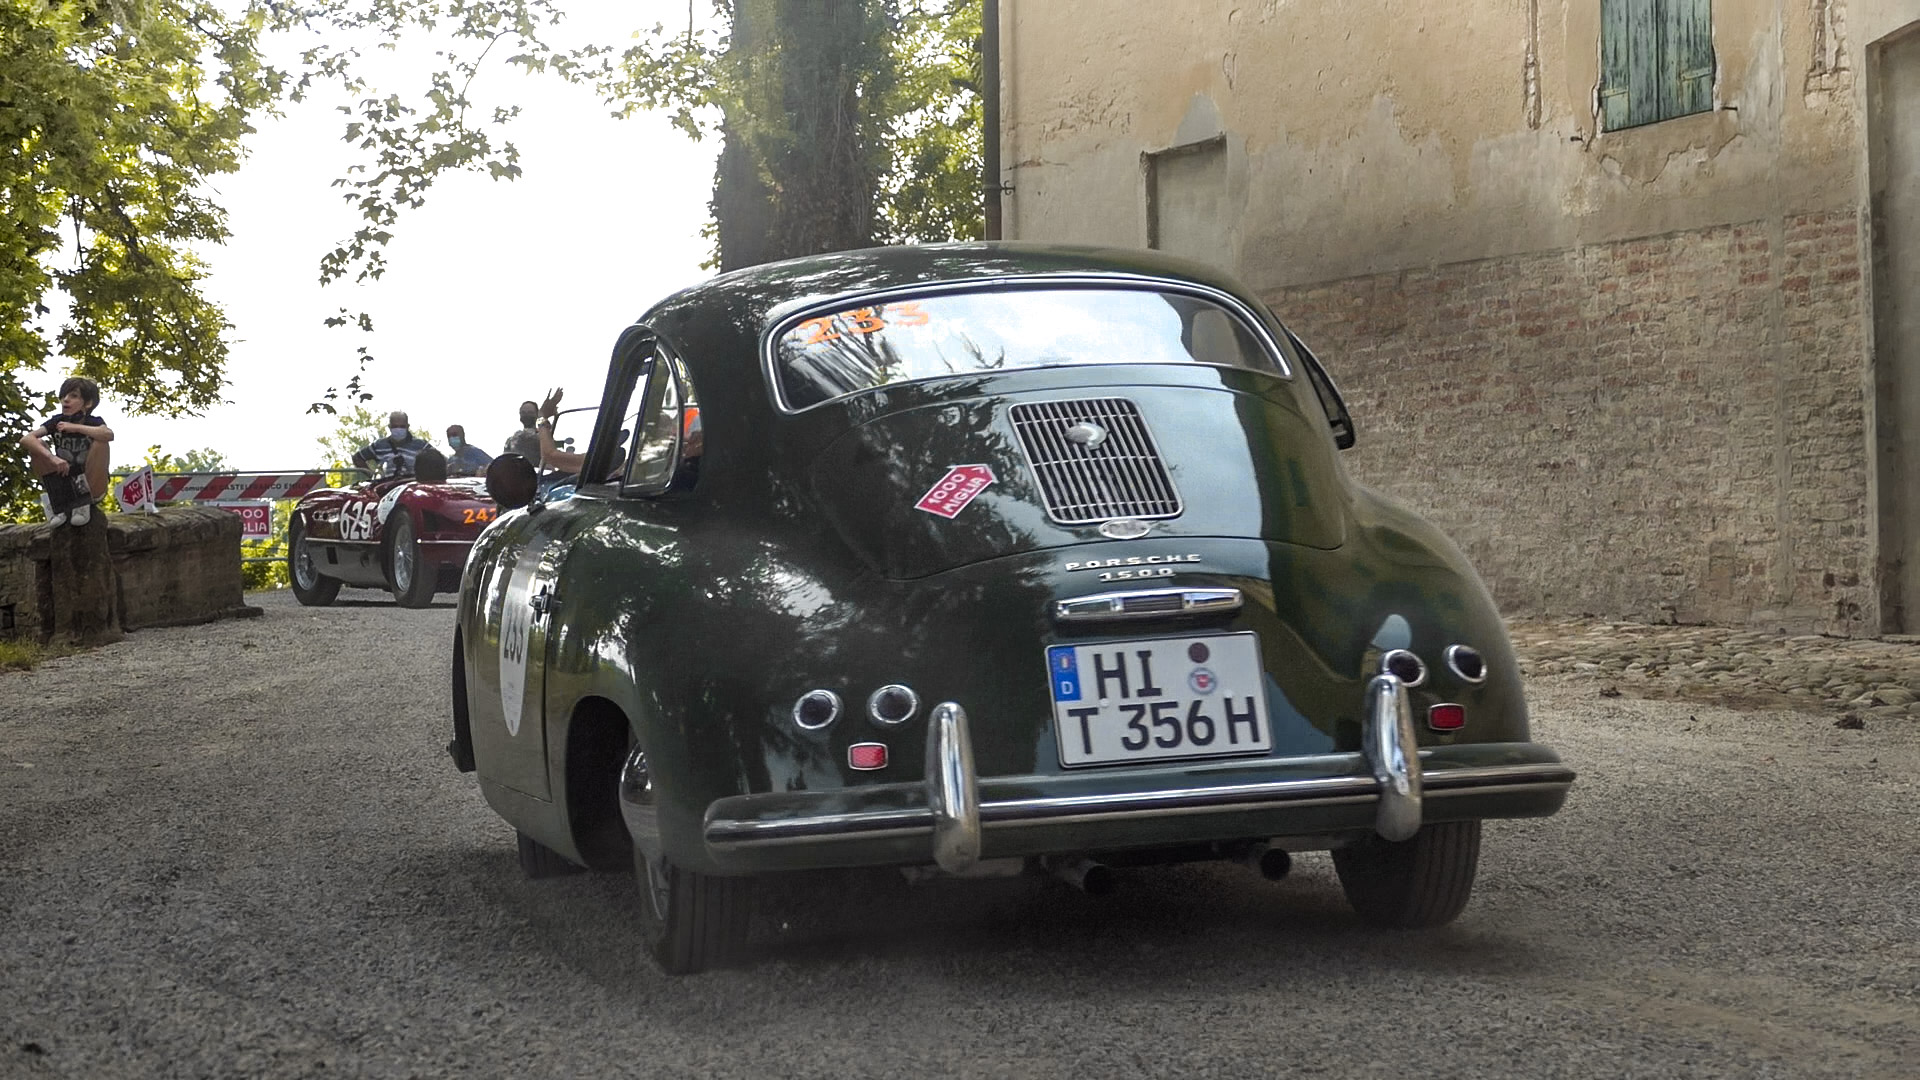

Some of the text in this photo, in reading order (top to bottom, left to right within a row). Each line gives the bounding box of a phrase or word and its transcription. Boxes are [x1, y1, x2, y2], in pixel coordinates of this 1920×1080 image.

[796, 302, 929, 344] 233
[928, 473, 966, 504] 1000
[942, 477, 987, 513] MIGLIA
[340, 500, 377, 540] 625
[1065, 554, 1201, 571] PORSCHE
[1098, 567, 1174, 581] 1500
[1061, 681, 1073, 695] D
[1094, 650, 1162, 699] HI
[1068, 707, 1098, 755] T
